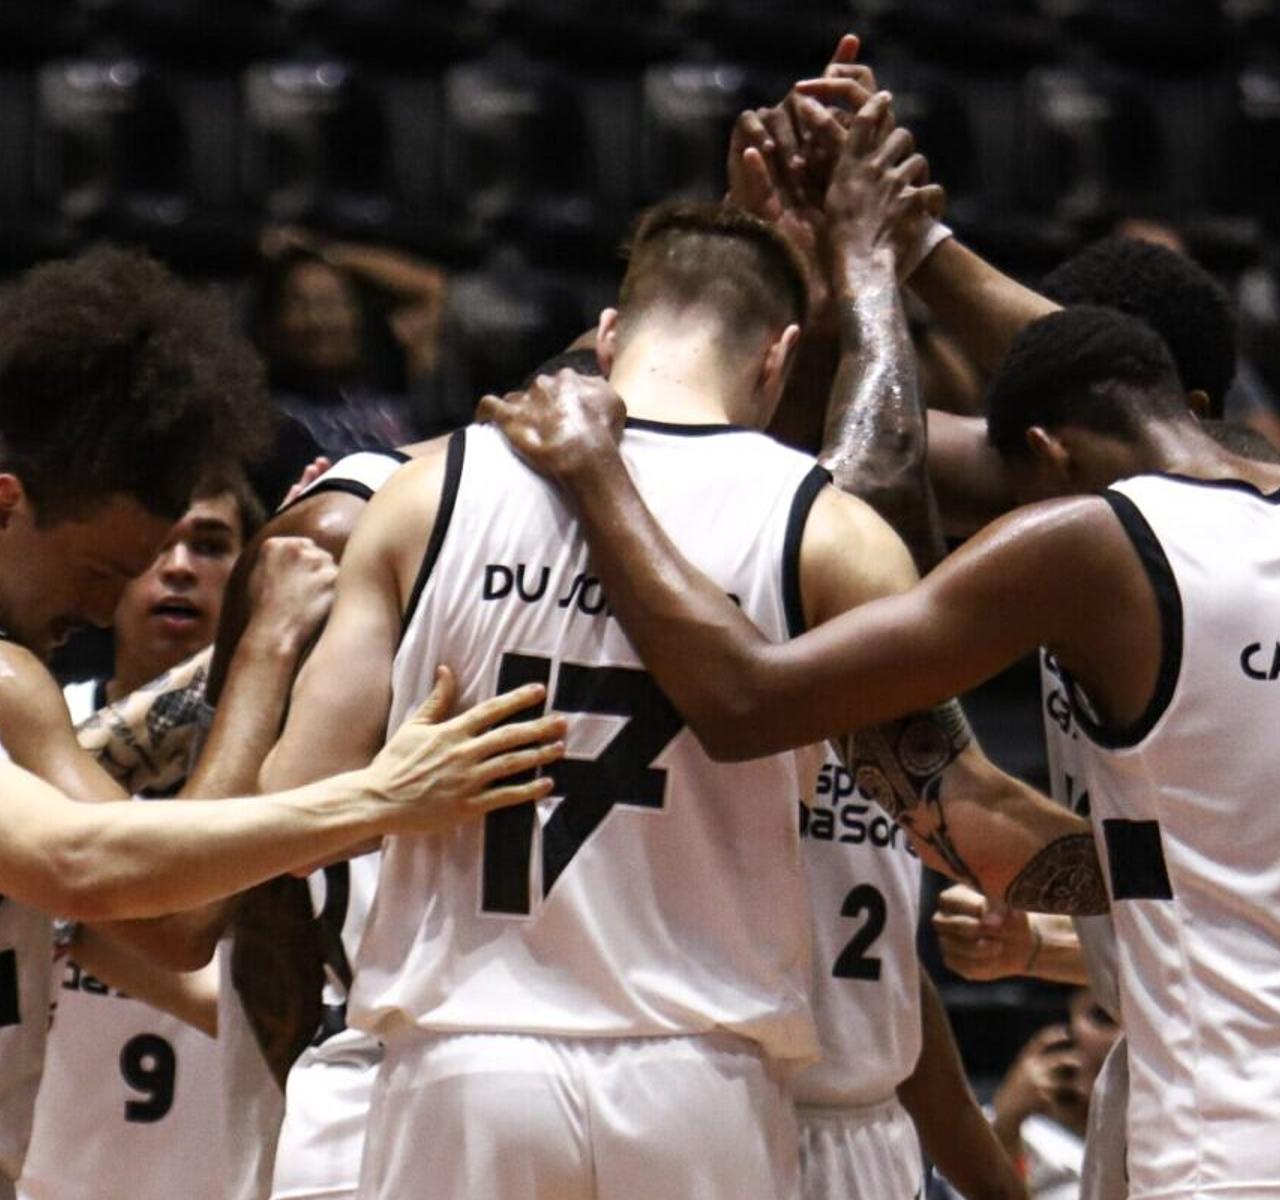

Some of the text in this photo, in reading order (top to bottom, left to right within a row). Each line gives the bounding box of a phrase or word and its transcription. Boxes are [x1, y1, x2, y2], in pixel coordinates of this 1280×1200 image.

[482, 563, 550, 604] DU
[481, 652, 687, 916] 17
[831, 882, 888, 983] 2
[119, 1032, 177, 1124] 9
